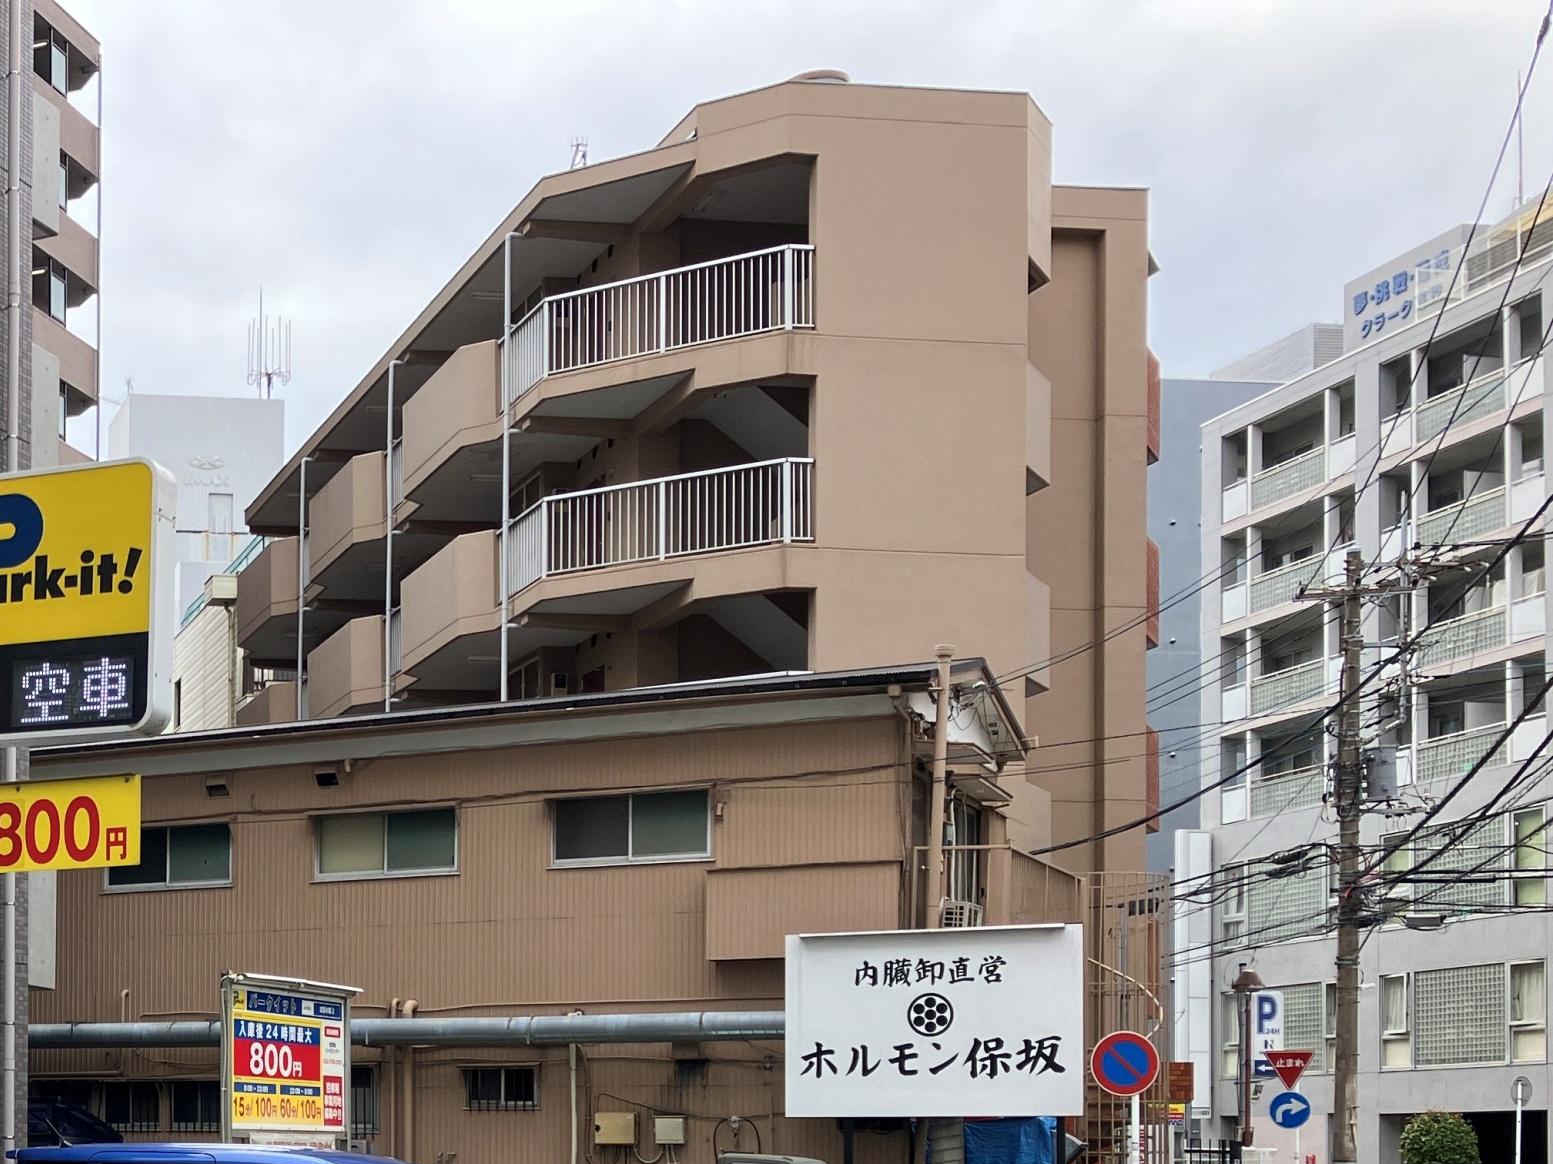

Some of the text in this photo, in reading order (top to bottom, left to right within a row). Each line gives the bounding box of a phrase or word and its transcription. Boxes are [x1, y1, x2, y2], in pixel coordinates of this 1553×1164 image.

[20, 657, 129, 725] 空車
[855, 955, 1007, 987] 内臓卸直営
[1256, 993, 1277, 1035] P
[249, 1042, 303, 1078] 800円
[800, 1036, 1066, 1079] ホルモン保坂
[1276, 1058, 1305, 1068] 止まれ
